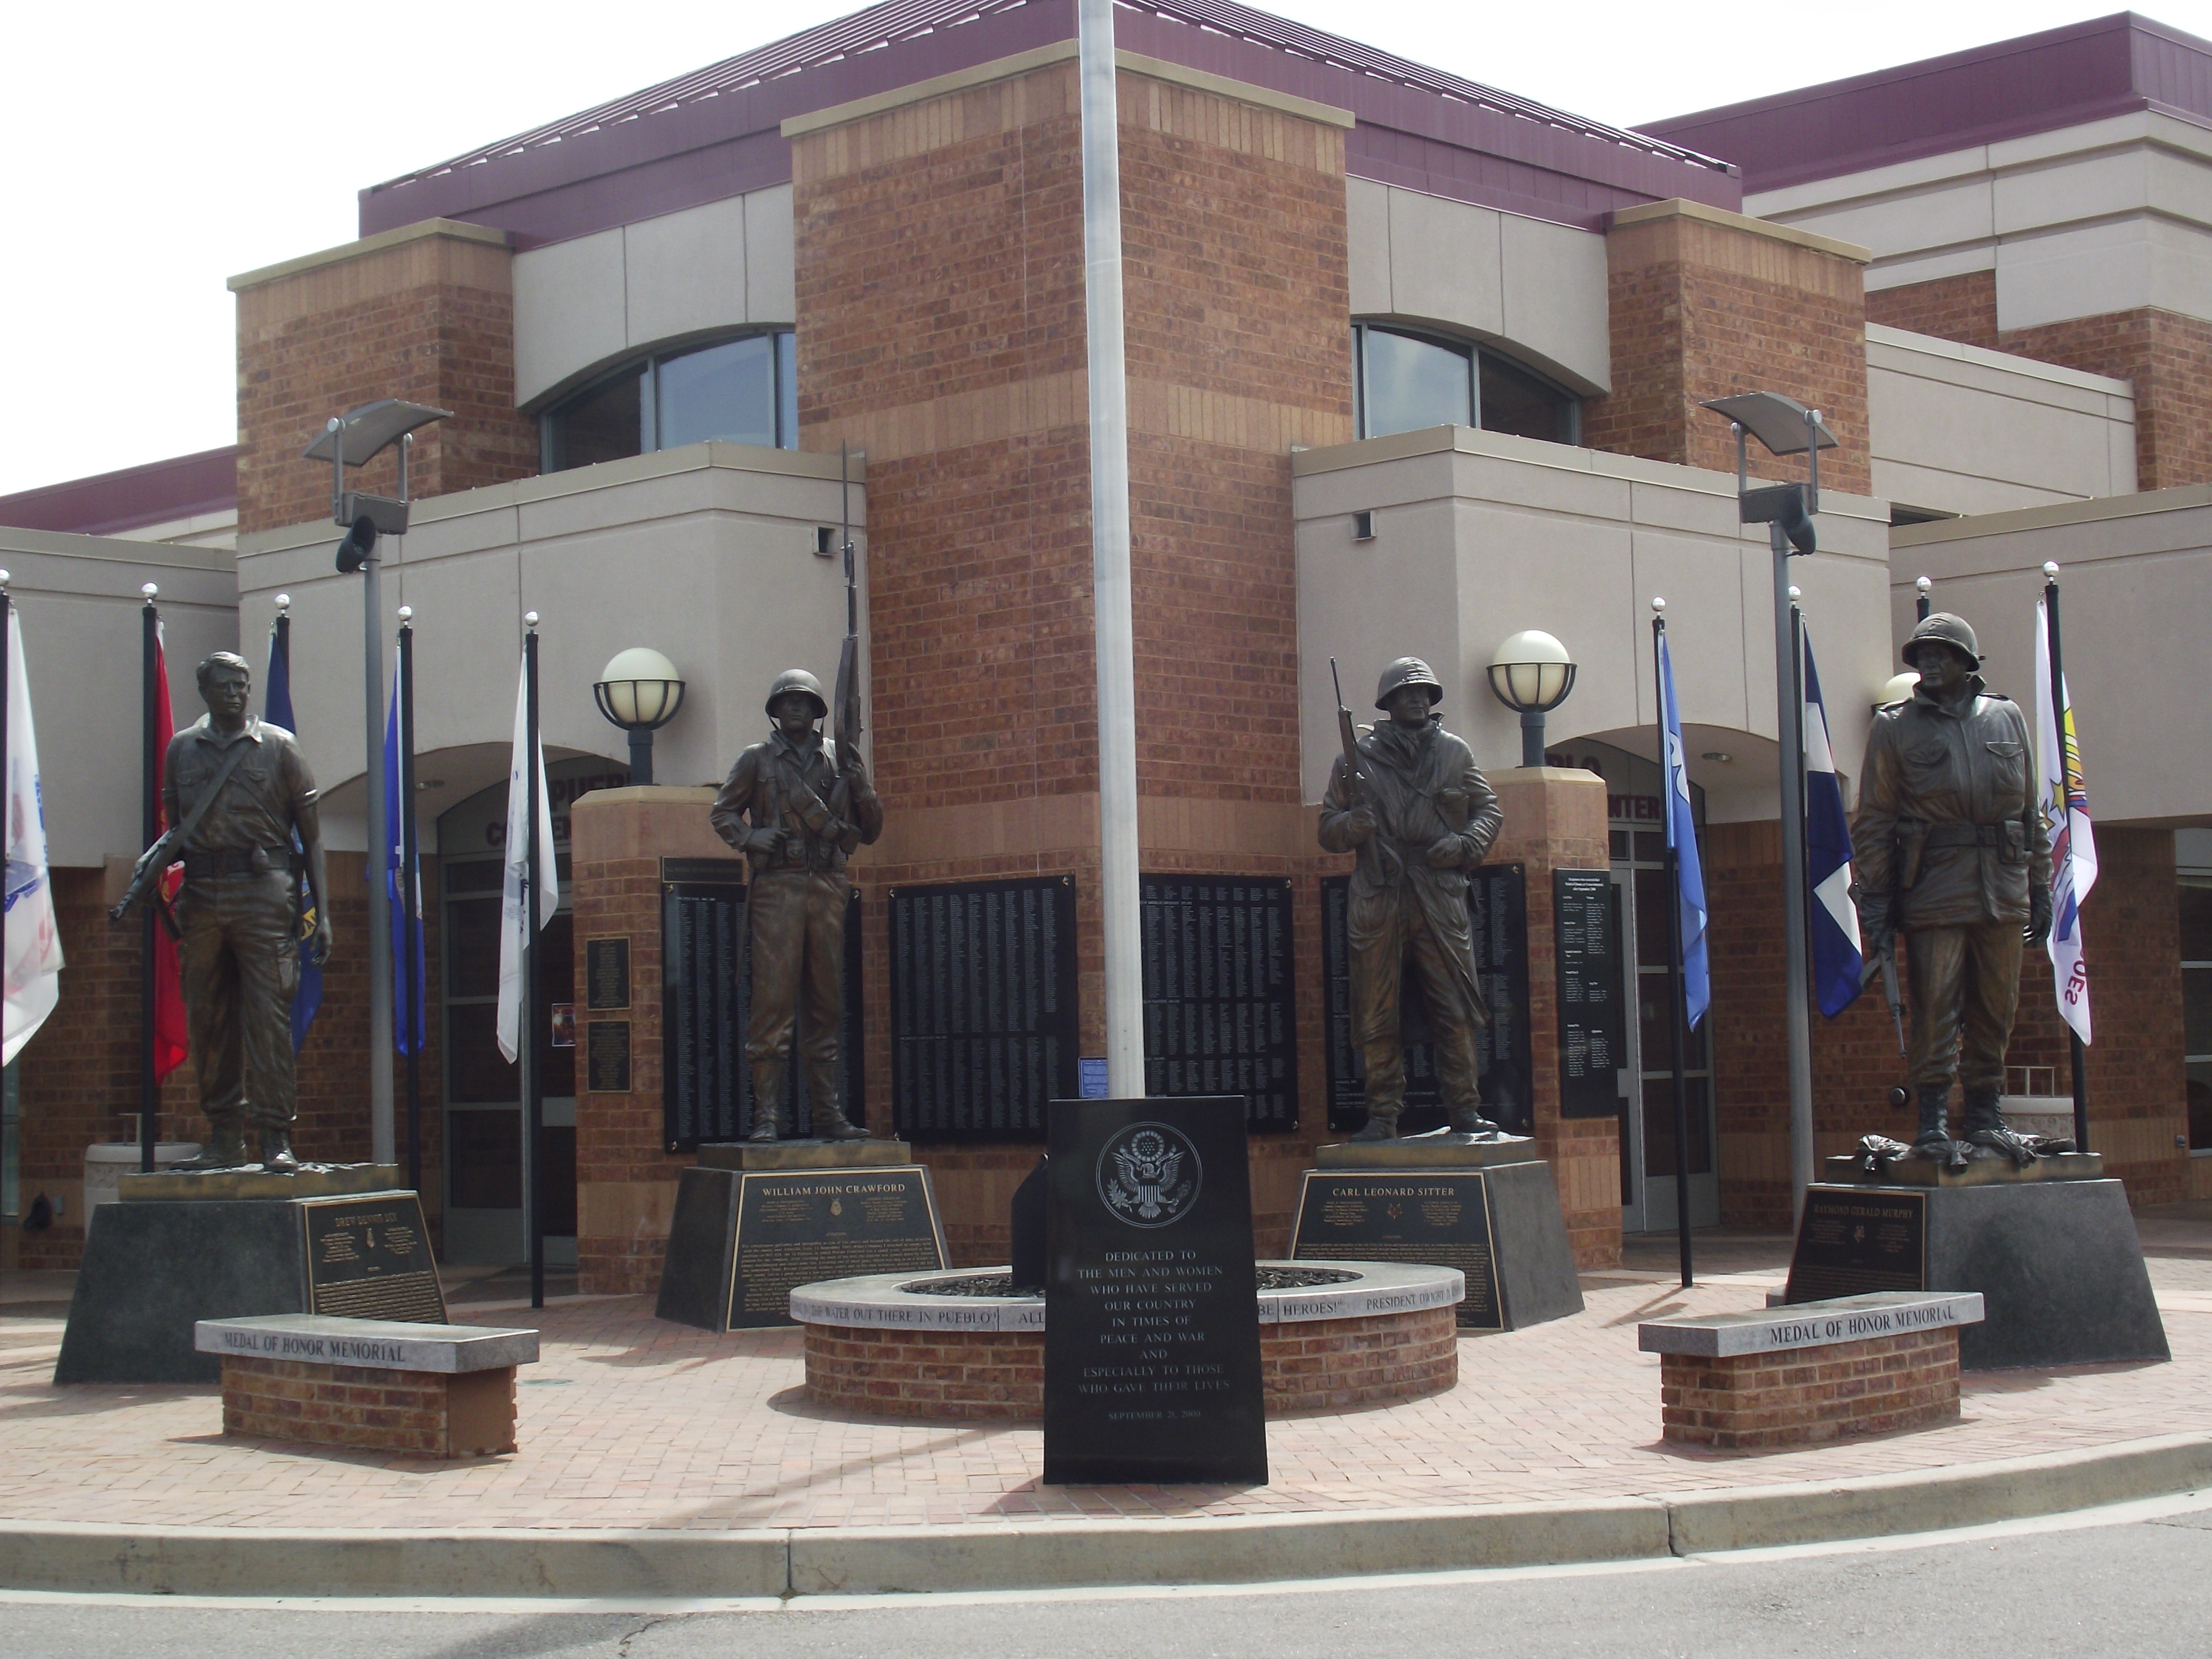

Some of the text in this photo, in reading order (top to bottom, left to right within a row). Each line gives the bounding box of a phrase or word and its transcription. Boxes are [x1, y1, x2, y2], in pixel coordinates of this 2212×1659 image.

[1608, 795, 1661, 819] NTER
[763, 1183, 905, 1196] WILLIAM JOHN CRAWFORD
[1333, 1188, 1360, 1196] CARL
[1814, 1204, 1913, 1219] RAYMOND GERALD MURPHY
[335, 1216, 356, 1227] DREW
[1105, 1250, 1196, 1262] DEDICATED TO
[1078, 1266, 1222, 1278] THE MEN AND WOMEN
[1091, 1282, 1212, 1295] WHO HAVE SERVED
[1105, 1300, 1196, 1310] OUR COUNTRY
[1367, 1294, 1416, 1310] PRESIDENT
[1420, 1291, 1444, 1304] DWIGHT
[812, 1305, 822, 1316] THE
[825, 1307, 849, 1320] WATER
[854, 1309, 873, 1320] OUT
[878, 1310, 912, 1322] THERE
[920, 1312, 931, 1323] IN
[1112, 1316, 1191, 1327] IN TIMES OF
[1771, 1305, 1954, 1344] MEDAL OF HONOR MEMORIAL
[1100, 1332, 1205, 1344] PEACE AND WAR
[225, 1332, 405, 1361] MEDAL OF HONOR MEMORIAL
[1140, 1349, 1167, 1359] AND
[1084, 1364, 1223, 1378] ESPECIALLY TO THOSE
[1079, 1380, 1229, 1394] WHO GAVE THEIR LIVES
[1109, 1411, 1162, 1420] SEPTEMBER
